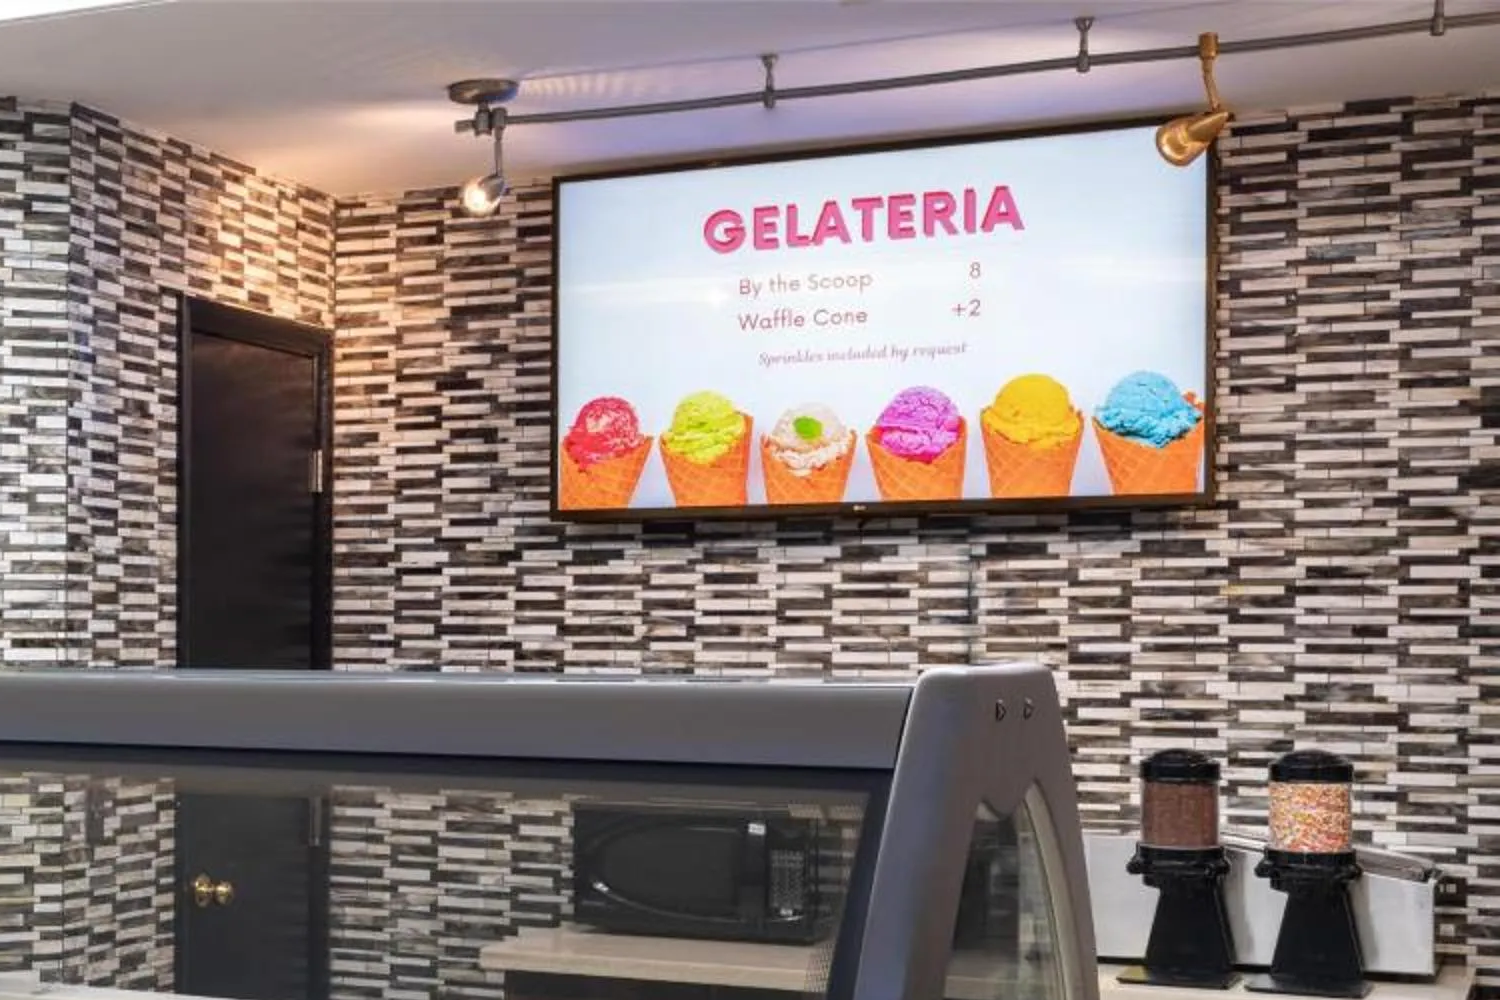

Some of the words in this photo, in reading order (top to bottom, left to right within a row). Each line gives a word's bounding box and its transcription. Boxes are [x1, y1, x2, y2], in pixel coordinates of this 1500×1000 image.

[703, 185, 1025, 255] GELATERIA
[739, 278, 762, 300] By
[769, 273, 801, 293] the
[807, 273, 874, 294] Scoop
[969, 261, 981, 279] 8
[738, 308, 806, 331] Waffle
[813, 308, 869, 326] Cone
[951, 299, 981, 317] +2
[758, 349, 824, 368] Sprinkles
[827, 344, 887, 362] included
[891, 344, 909, 362] by
[912, 341, 967, 359] request
